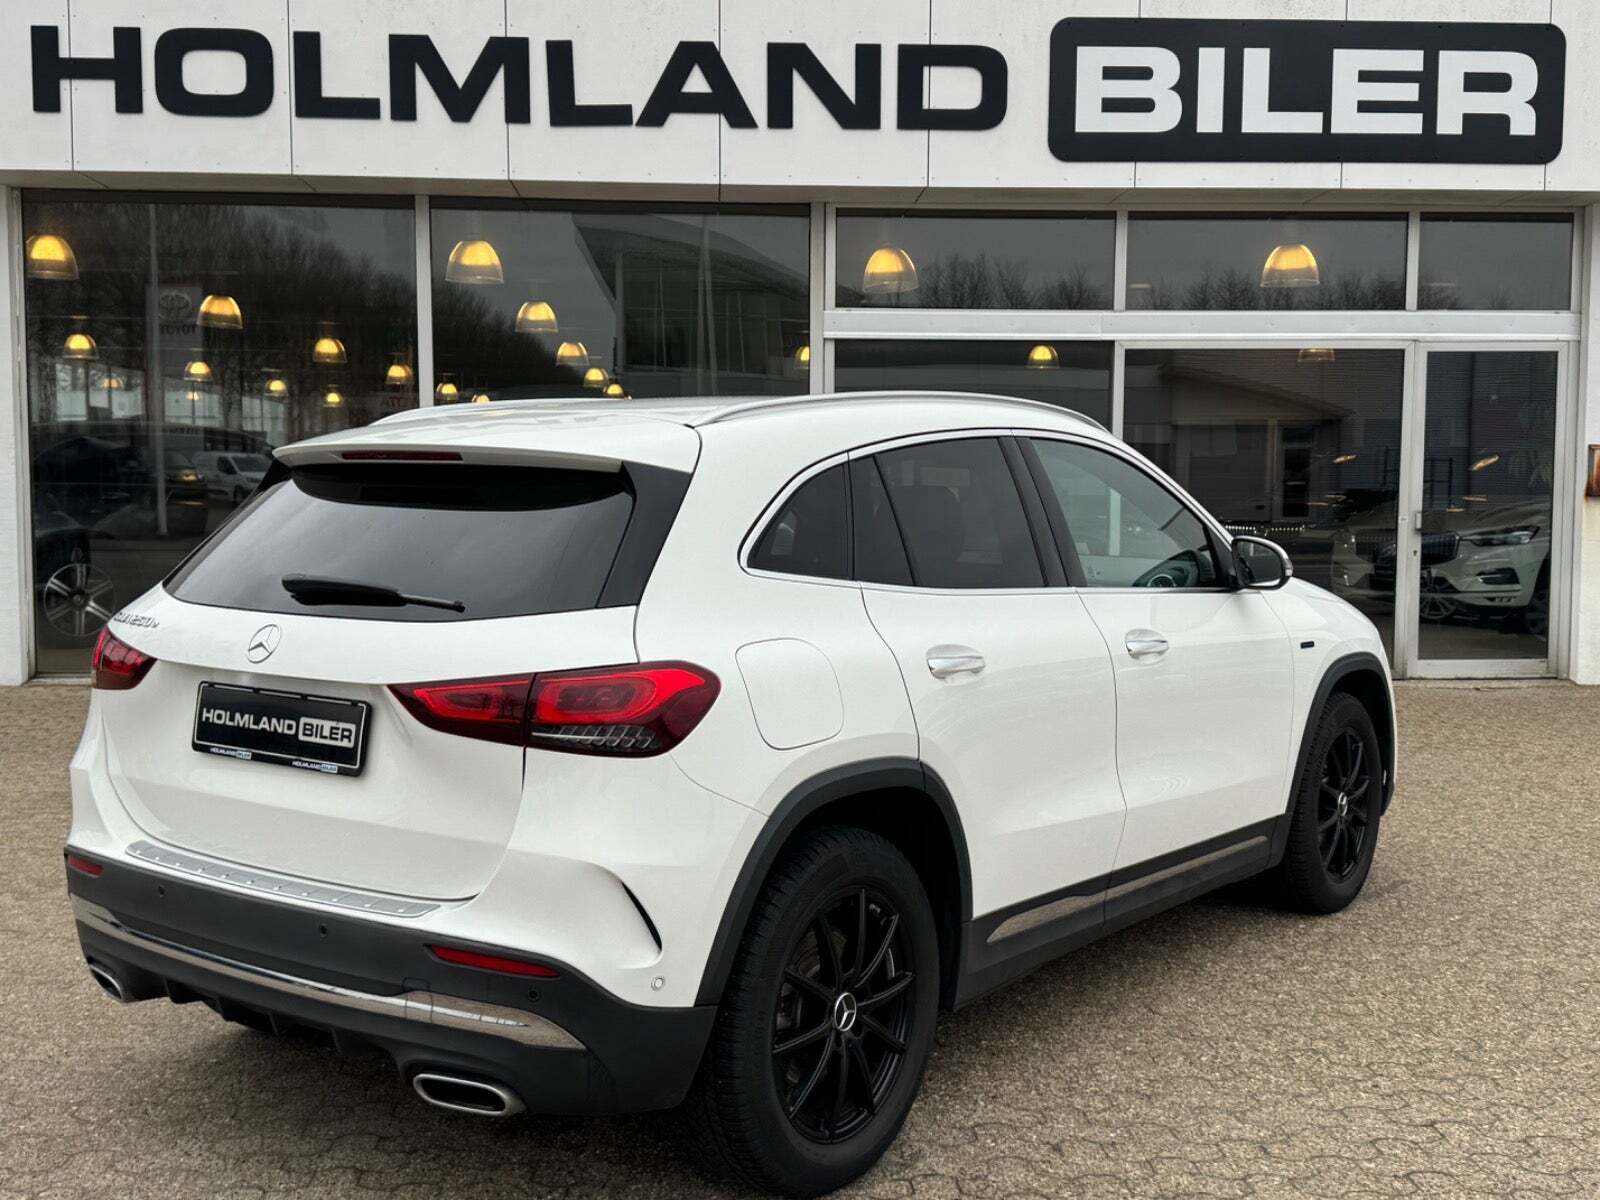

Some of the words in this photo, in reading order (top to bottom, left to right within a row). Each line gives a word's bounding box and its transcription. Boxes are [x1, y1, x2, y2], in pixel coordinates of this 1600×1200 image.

[31, 25, 1008, 131] HOLMLAND
[1075, 45, 1539, 137] BILER
[201, 707, 297, 735] HOLMLAND
[302, 722, 353, 743] BILER
